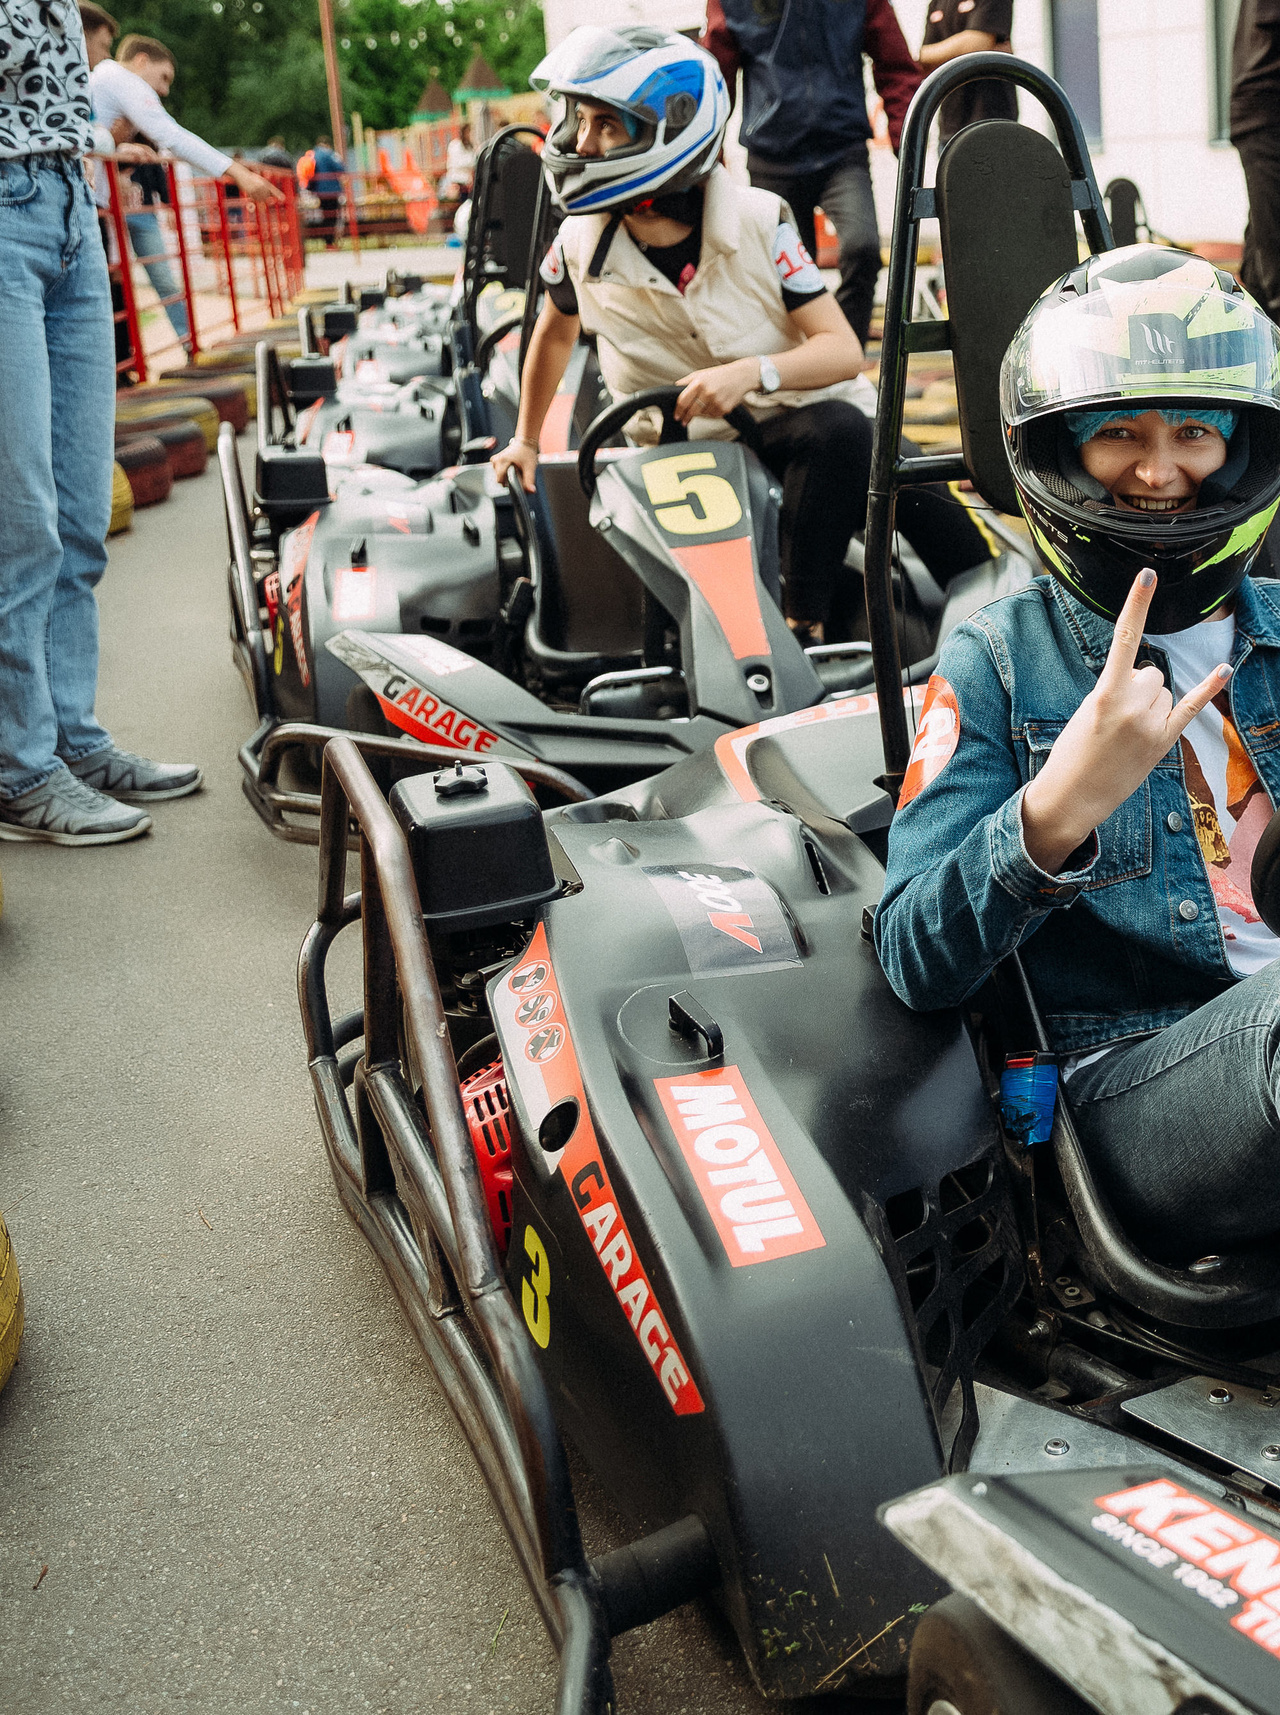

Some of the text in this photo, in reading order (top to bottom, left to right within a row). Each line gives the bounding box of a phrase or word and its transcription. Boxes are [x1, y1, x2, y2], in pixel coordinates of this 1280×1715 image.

[641, 452, 743, 535] 5
[383, 675, 499, 754] GARAGE
[669, 1084, 805, 1254] MOTUL
[521, 1224, 551, 1350] 3
[571, 1160, 689, 1405] GARAGE
[1091, 1513, 1179, 1568] SINCE
